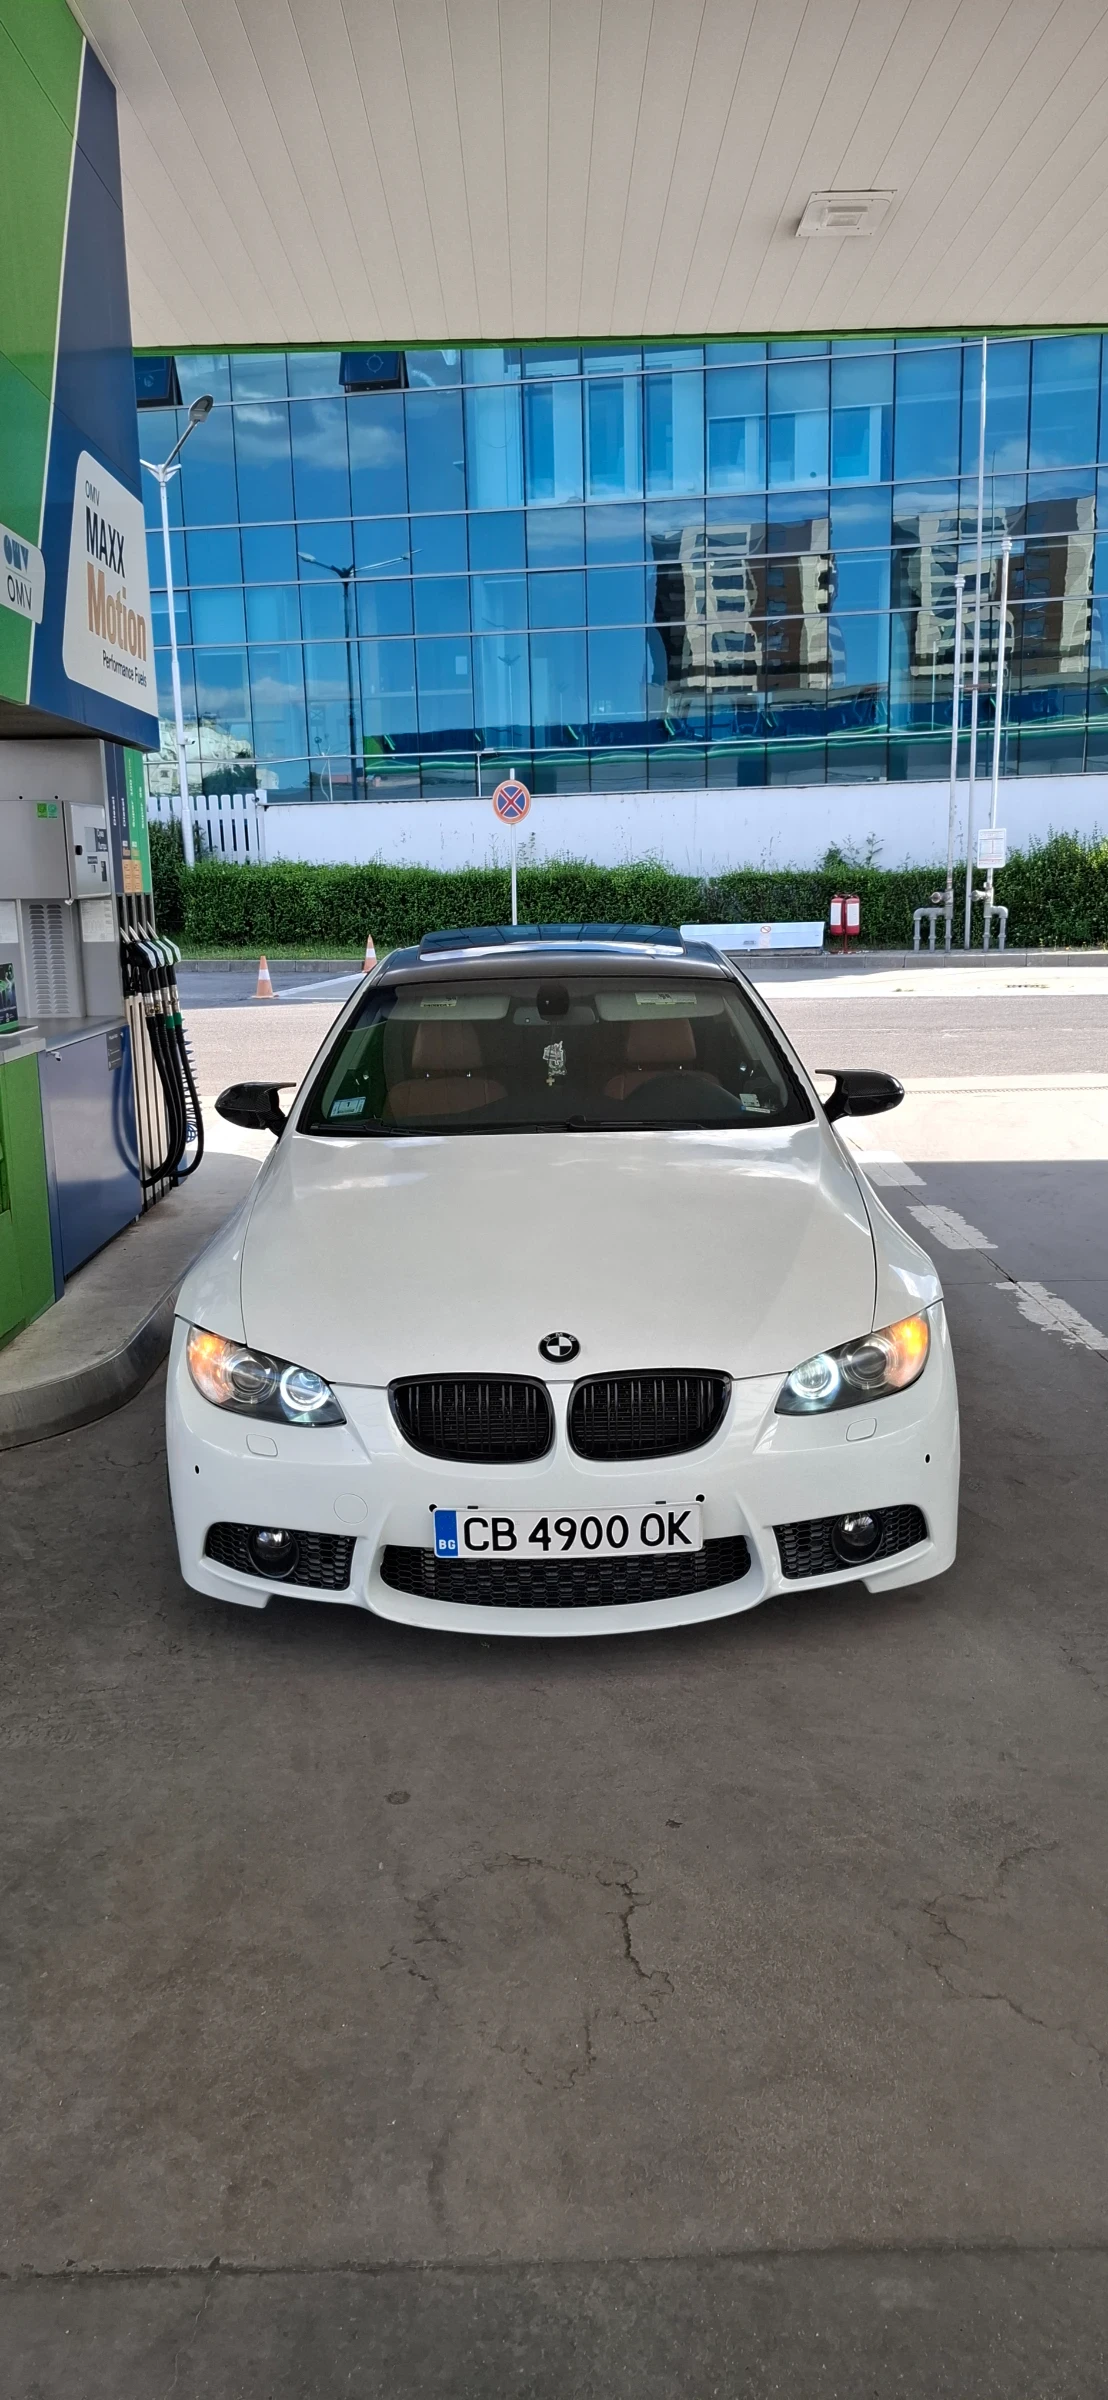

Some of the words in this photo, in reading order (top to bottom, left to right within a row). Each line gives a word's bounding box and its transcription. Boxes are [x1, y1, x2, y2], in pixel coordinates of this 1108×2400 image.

[84, 479, 101, 505] OMV
[85, 505, 126, 579] MAXX
[7, 574, 32, 611] OMV
[86, 560, 148, 663] Motion
[102, 649, 134, 682] Performance
[134, 666, 147, 688] Fuels
[438, 1538, 456, 1550] BG
[463, 1517, 518, 1551] CB
[527, 1514, 629, 1551] 4900
[640, 1510, 693, 1547] OK
